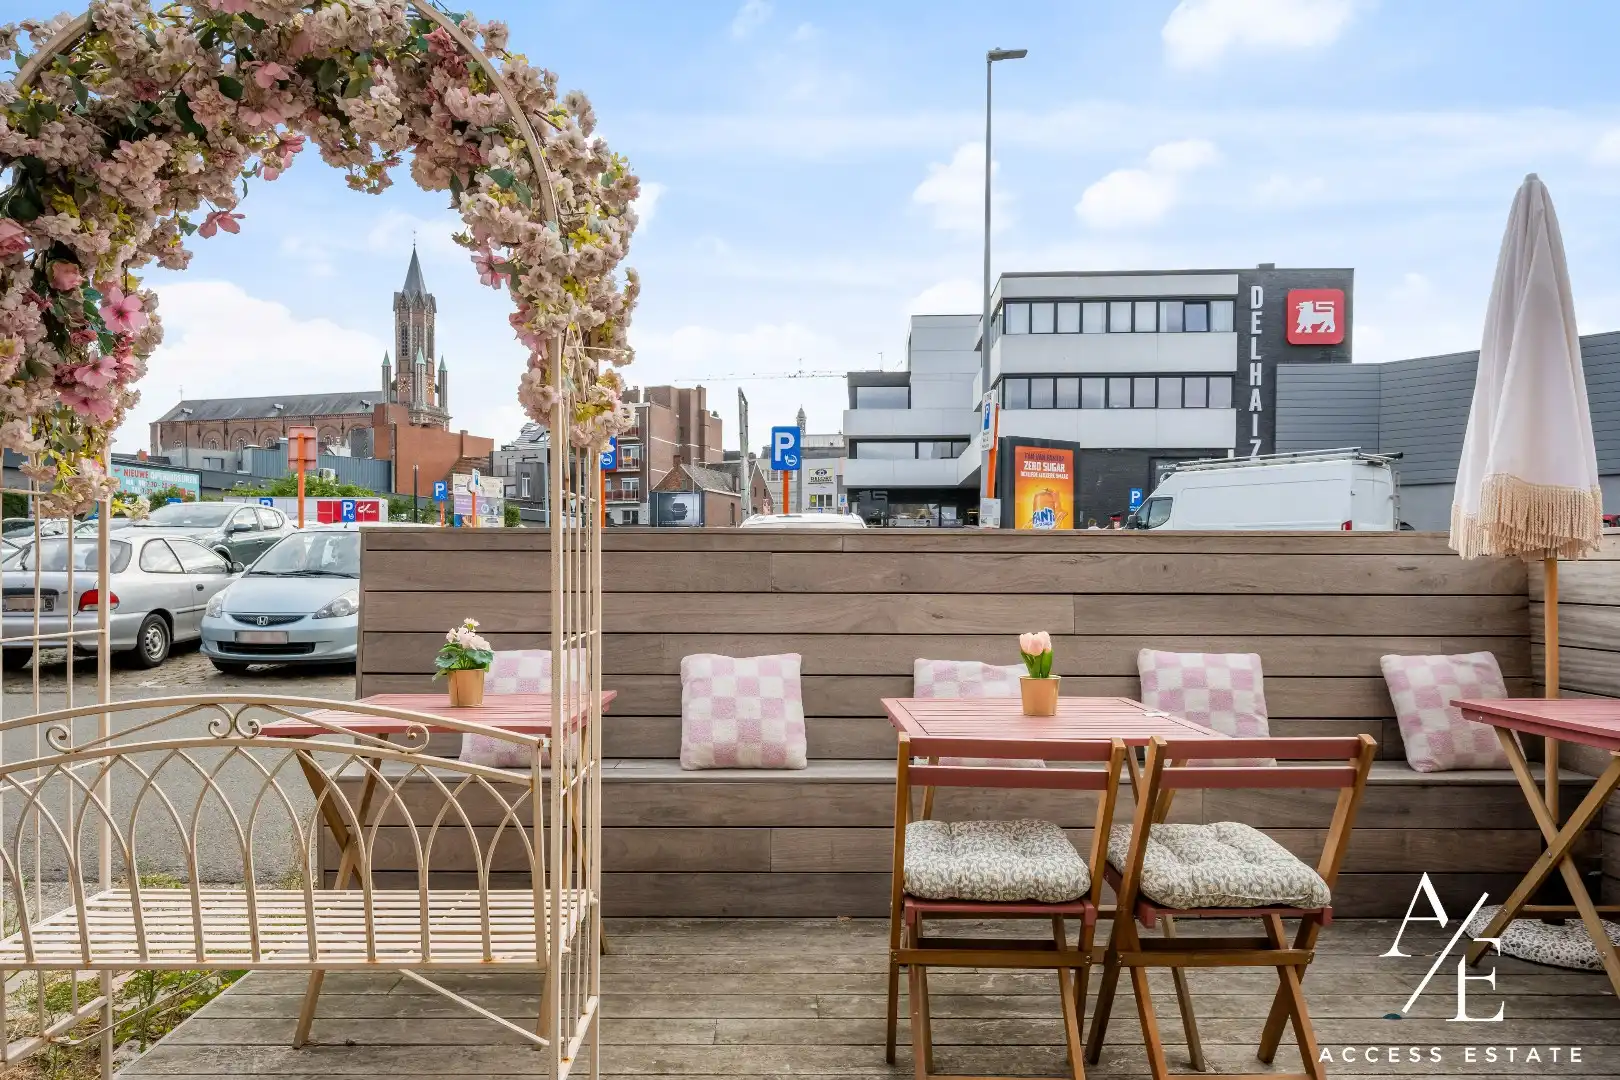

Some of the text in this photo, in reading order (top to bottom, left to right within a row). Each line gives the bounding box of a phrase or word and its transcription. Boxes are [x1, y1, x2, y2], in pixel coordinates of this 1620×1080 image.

[774, 432, 795, 462] P
[1023, 460, 1066, 473] ZERO SUGAR
[123, 468, 149, 479] NIEUWE
[435, 483, 445, 497] P
[1131, 490, 1141, 503] P
[343, 501, 353, 516] P
